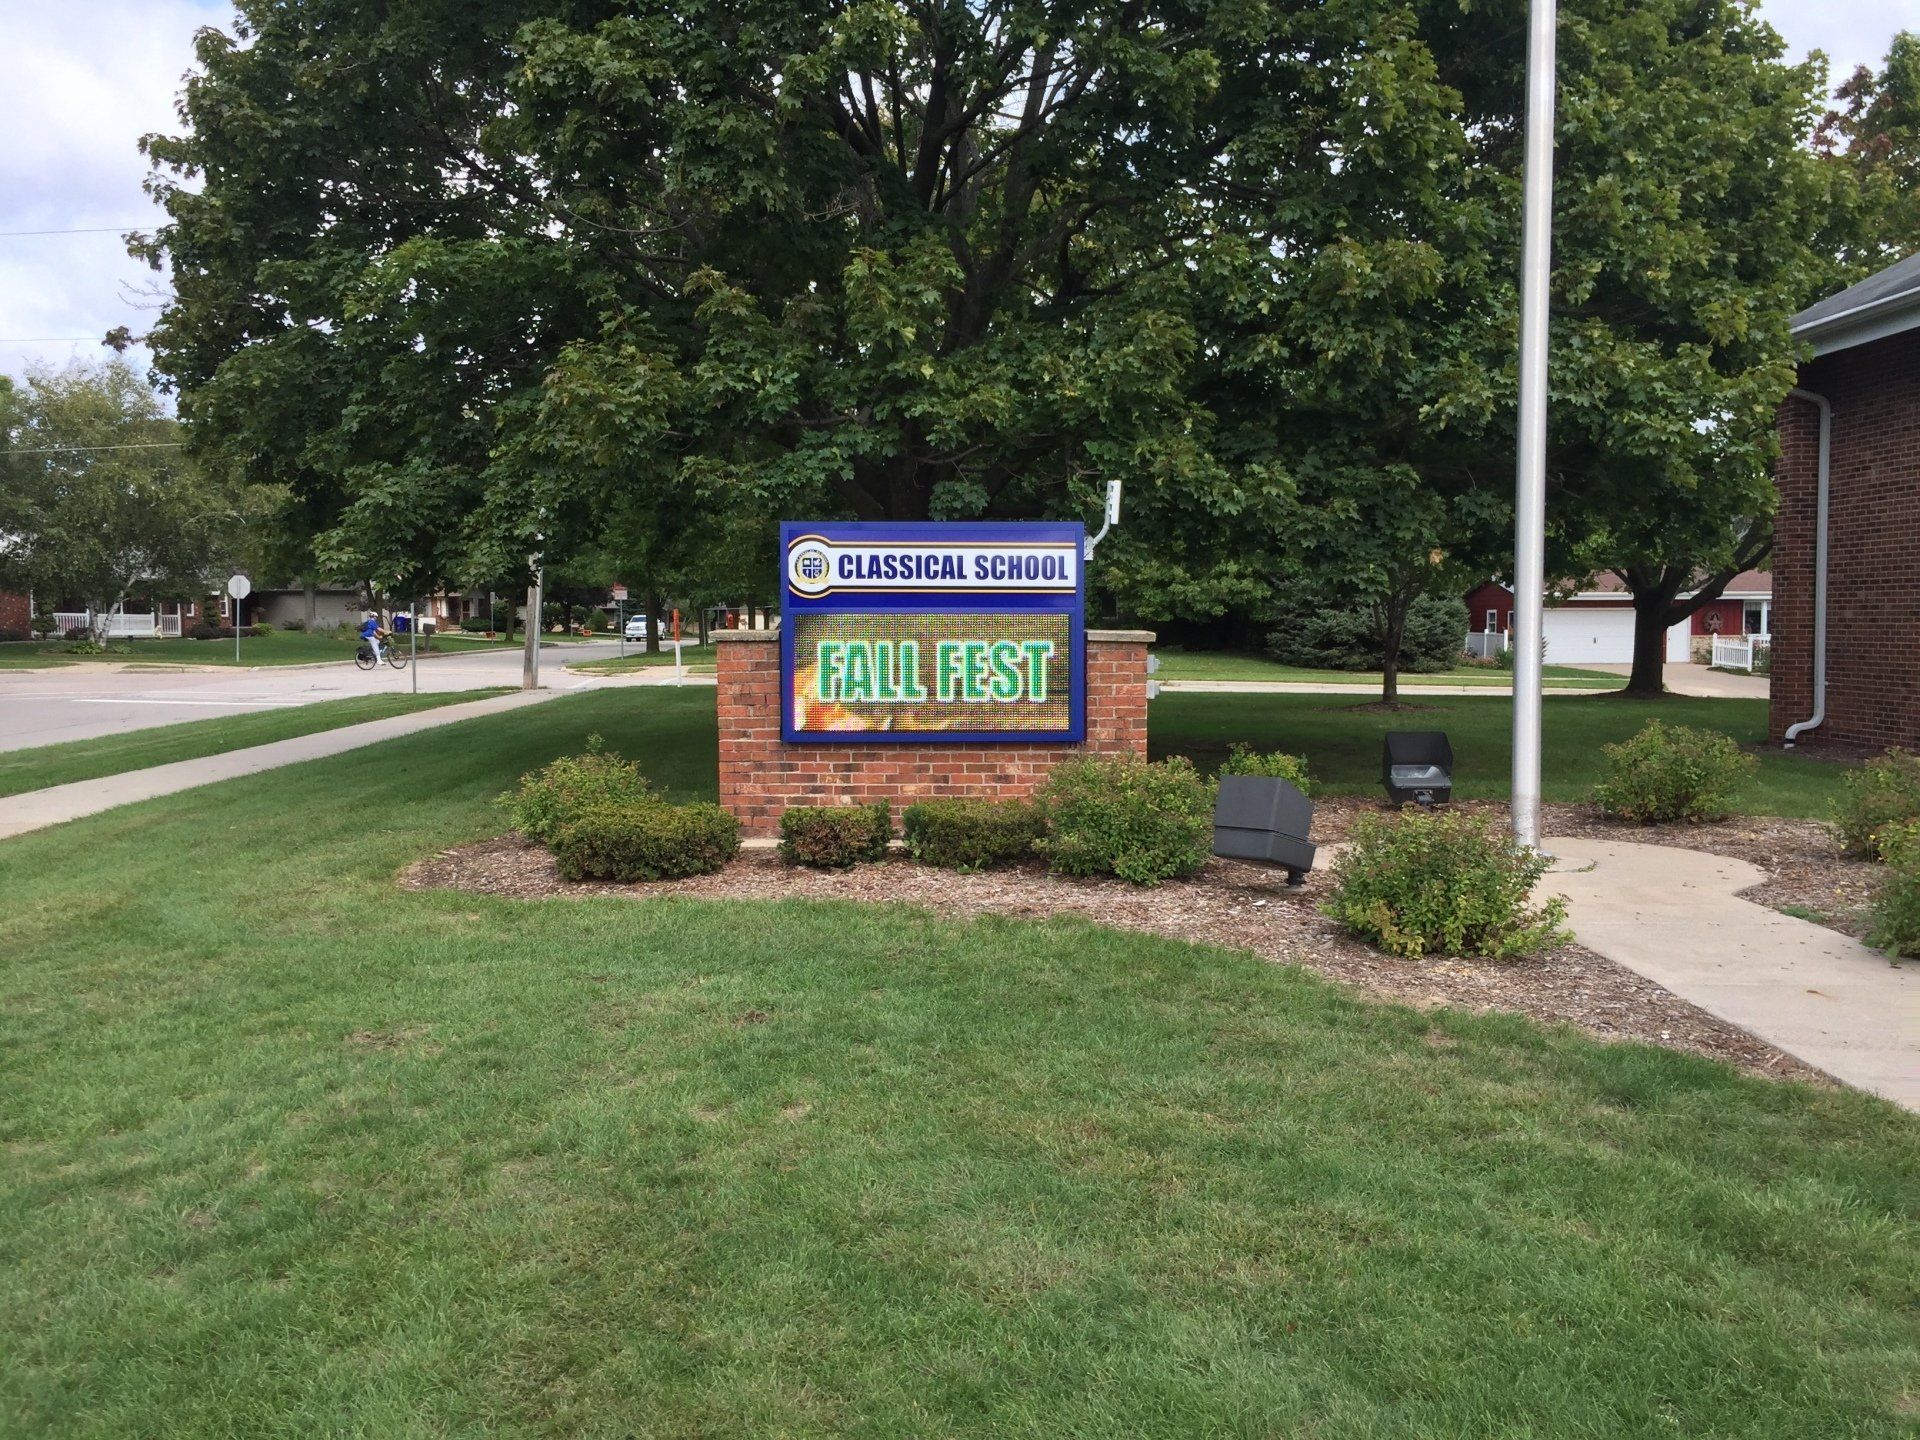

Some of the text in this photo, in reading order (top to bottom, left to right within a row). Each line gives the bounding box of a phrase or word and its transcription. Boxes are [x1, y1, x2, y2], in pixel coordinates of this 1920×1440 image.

[838, 554, 968, 580] CLASSICAL
[974, 554, 1069, 581] SCHOOL
[817, 640, 1054, 703] FALL FEST
